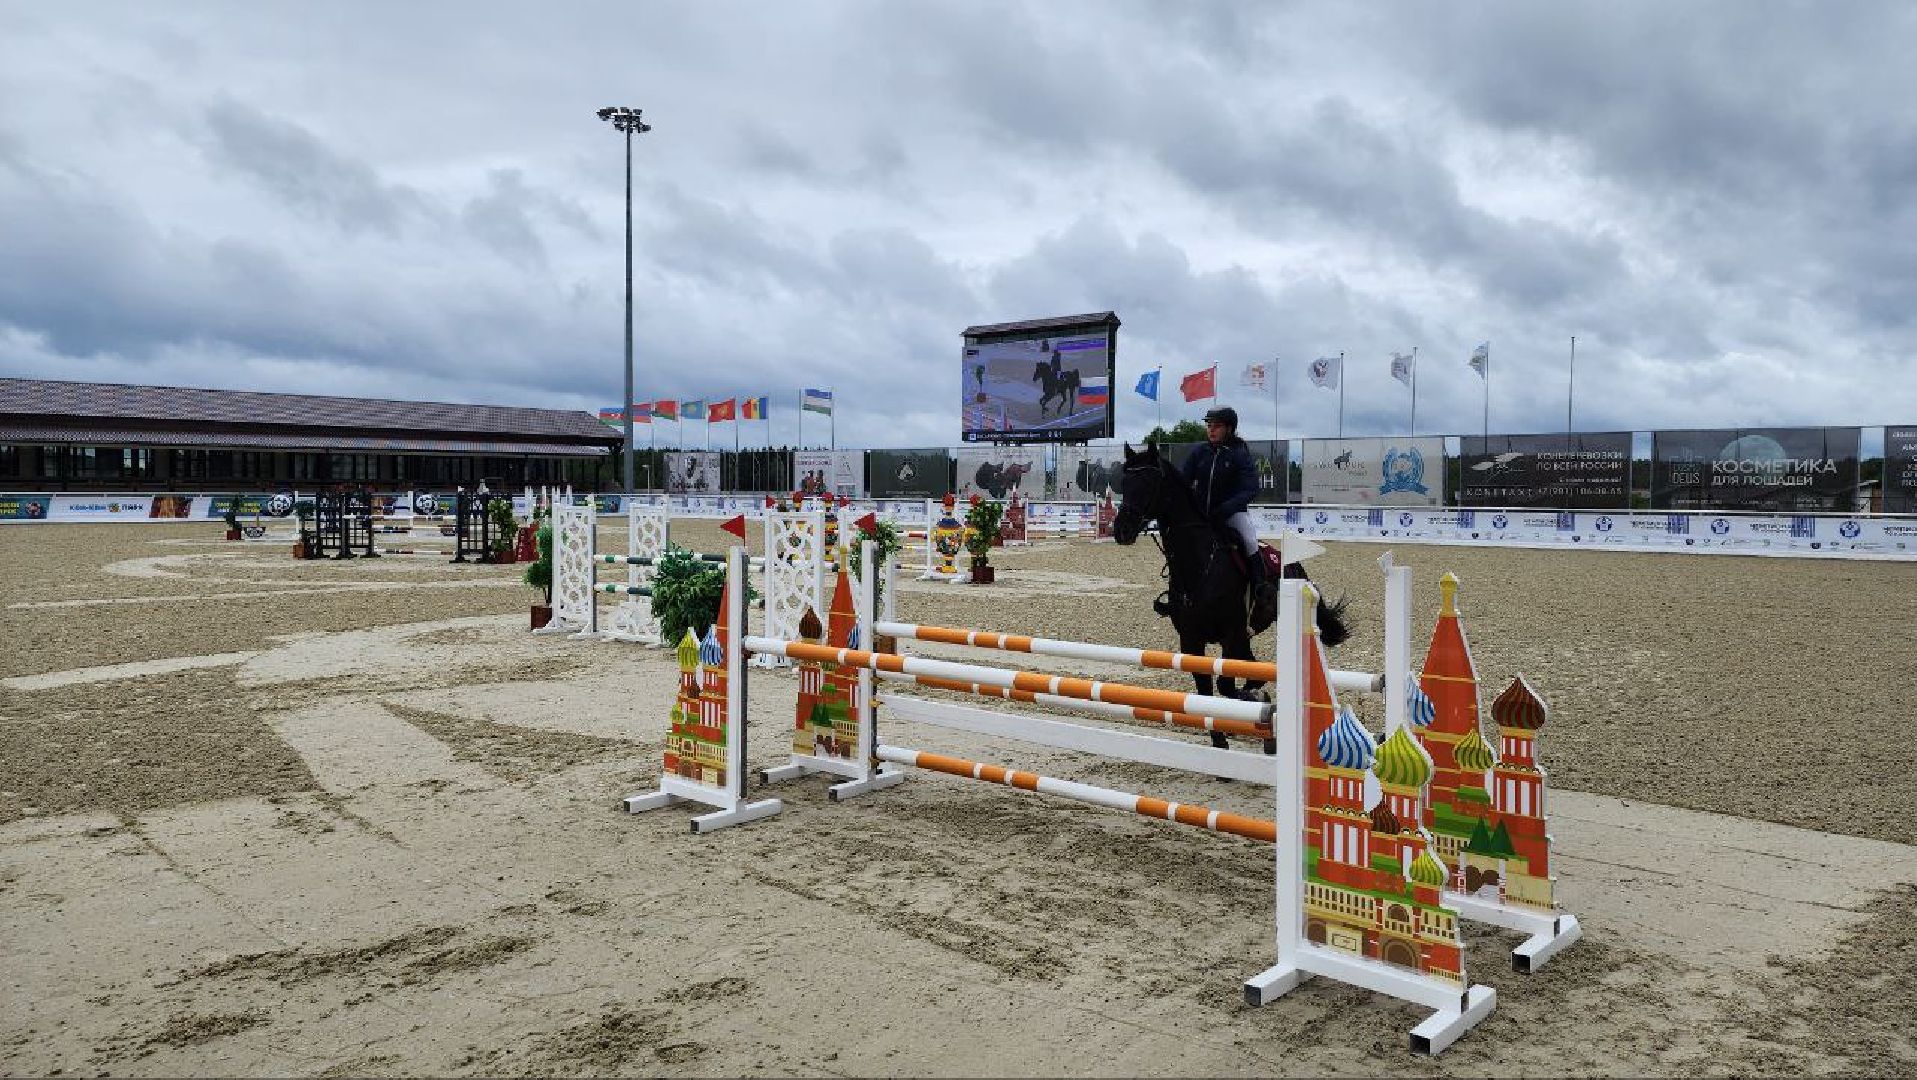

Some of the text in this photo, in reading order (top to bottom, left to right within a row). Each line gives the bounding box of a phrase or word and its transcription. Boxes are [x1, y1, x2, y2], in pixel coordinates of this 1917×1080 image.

[1580, 461, 1622, 471] РОССИИ
[1712, 458, 1838, 474] КОСМЕТИКА
[1711, 474, 1813, 487] ДЛЯ ЛОШАДЕЙ
